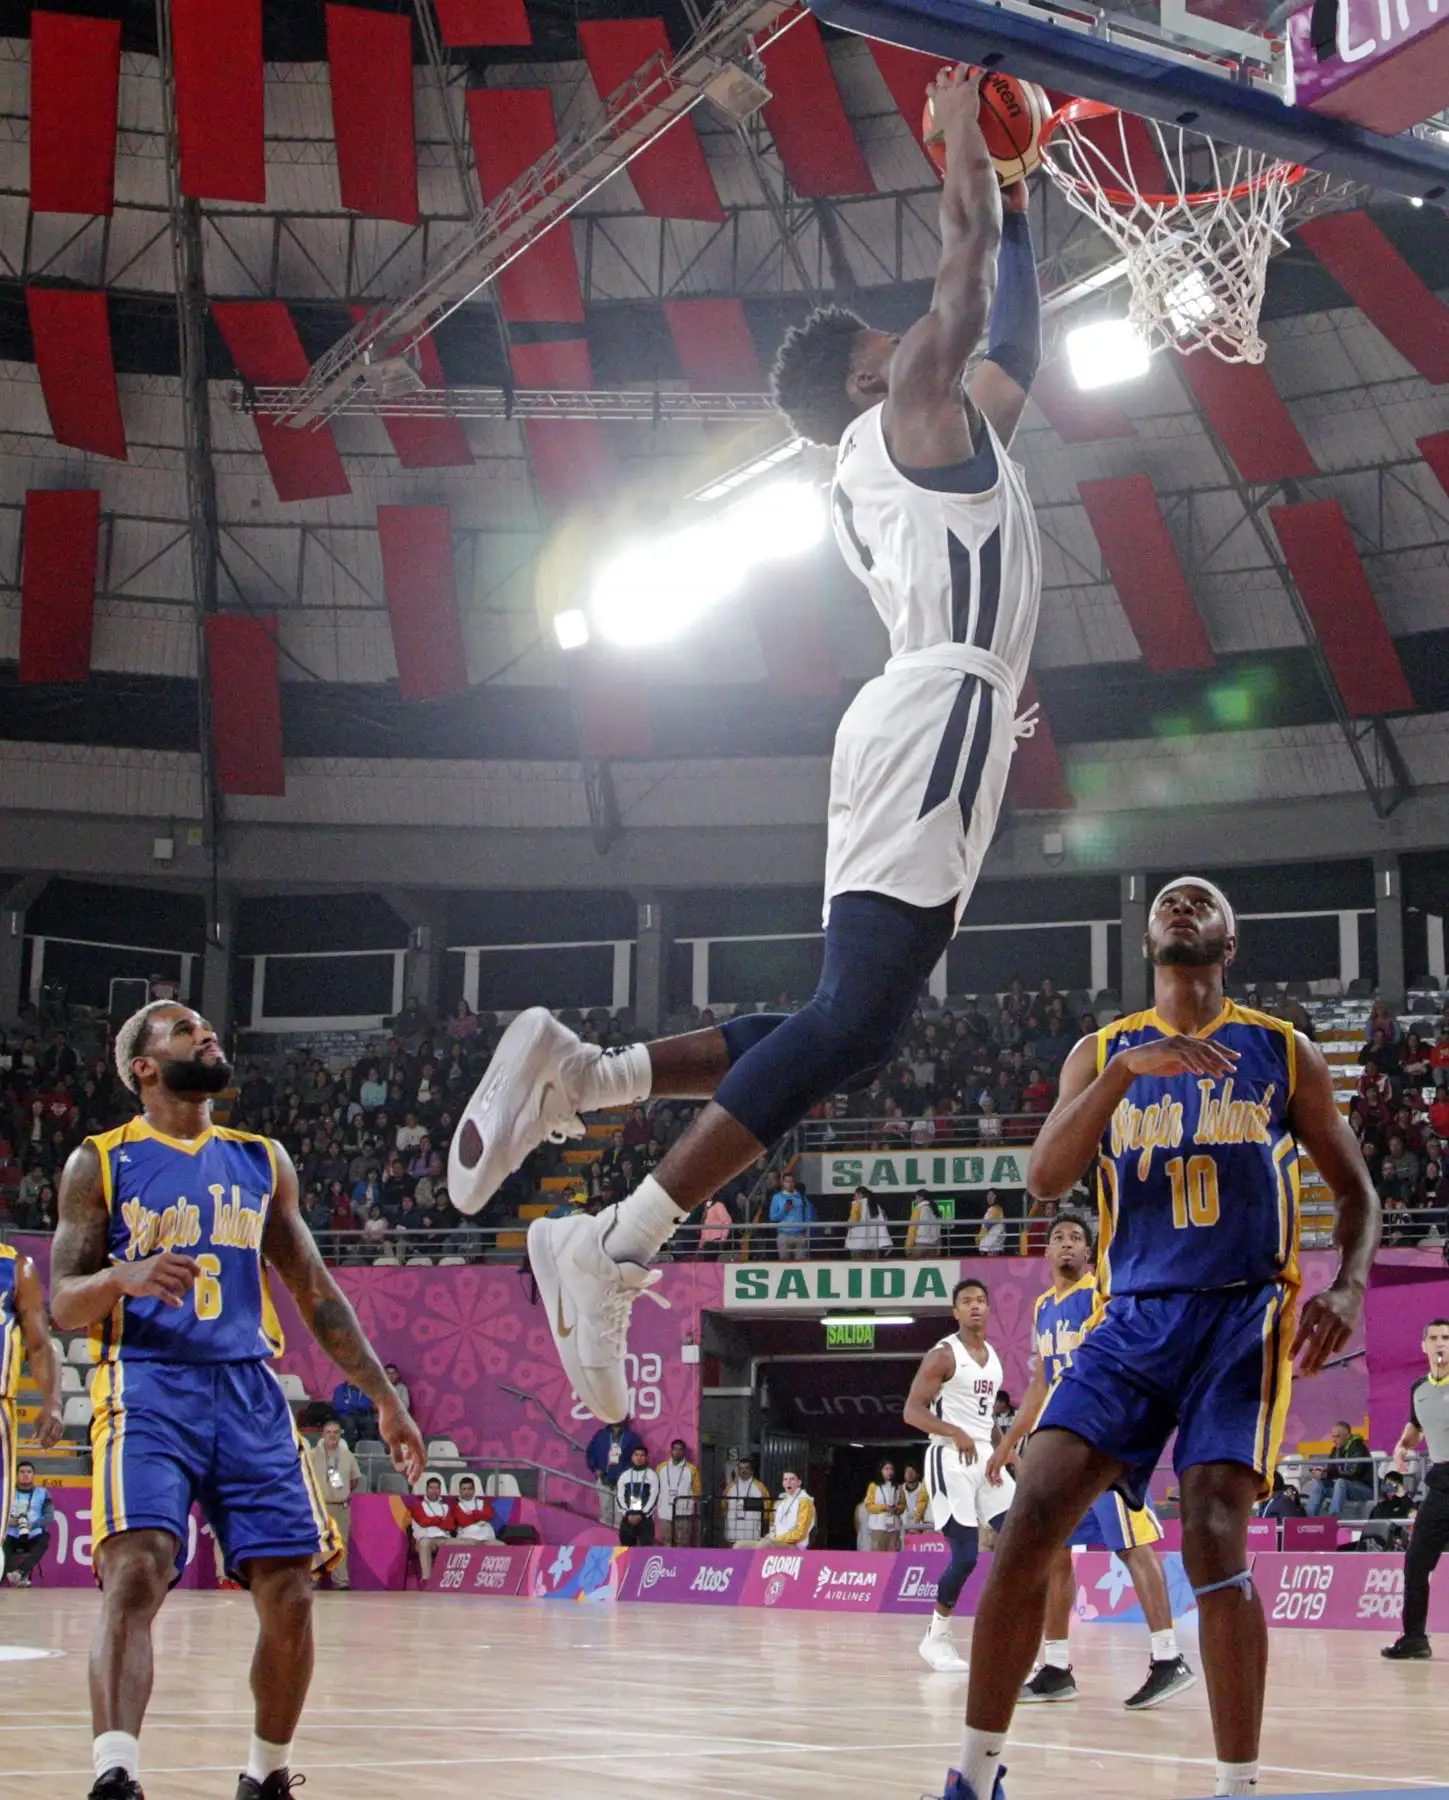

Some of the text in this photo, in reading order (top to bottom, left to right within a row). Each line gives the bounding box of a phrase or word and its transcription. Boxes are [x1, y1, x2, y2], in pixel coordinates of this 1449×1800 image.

[1111, 1093, 1184, 1182] Virgin
[832, 1155, 1022, 1187] SALIDA
[1165, 1154, 1220, 1229] 10
[208, 1183, 270, 1250] Island
[194, 1253, 223, 1321] 6
[735, 1267, 948, 1299] SALIDA
[828, 1324, 873, 1345] SALIDA
[973, 1379, 994, 1395] USA
[978, 1397, 987, 1416] 5
[440, 1570, 464, 1588] 2019
[762, 1555, 803, 1580] GLORIA
[831, 1571, 878, 1587] LATAM
[825, 1590, 872, 1602] AIRLINES
[1272, 1593, 1326, 1620] 2019
[1356, 1594, 1405, 1619] SPOR
